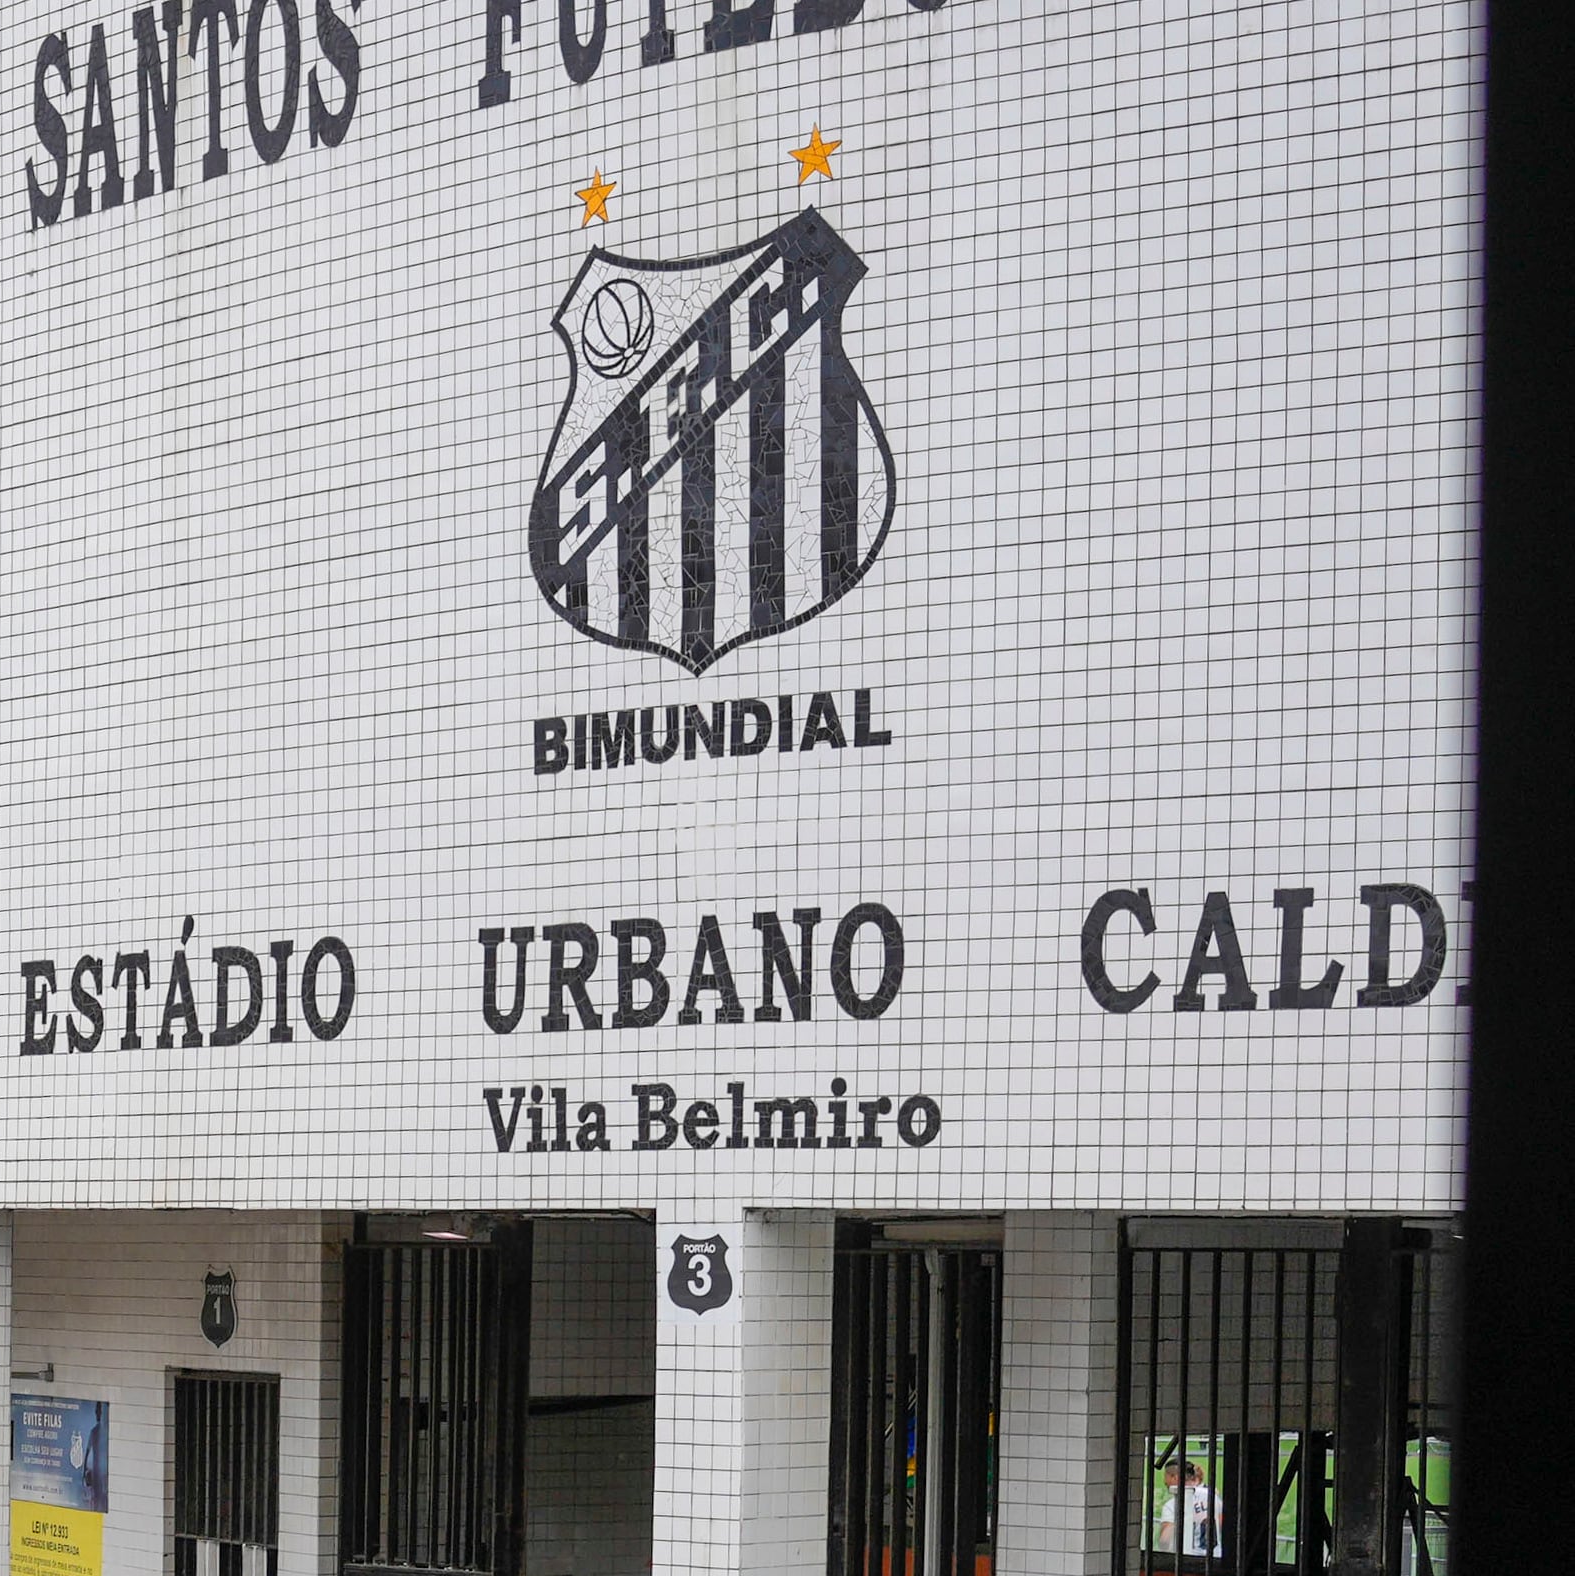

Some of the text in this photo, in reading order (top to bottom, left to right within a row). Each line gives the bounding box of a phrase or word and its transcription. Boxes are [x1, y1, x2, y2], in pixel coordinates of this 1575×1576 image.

[26, 0, 360, 232] SANTOS
[534, 687, 893, 777] BIMUNDIAL
[20, 914, 357, 1056] ESTÁDIO
[478, 902, 905, 1034] URBANO
[483, 1077, 942, 1154] Vila Belmiro
[682, 1241, 717, 1254] PORTÃO
[687, 1253, 713, 1297] 3
[213, 1295, 222, 1325] 1
[23, 1411, 43, 1427] EVITE
